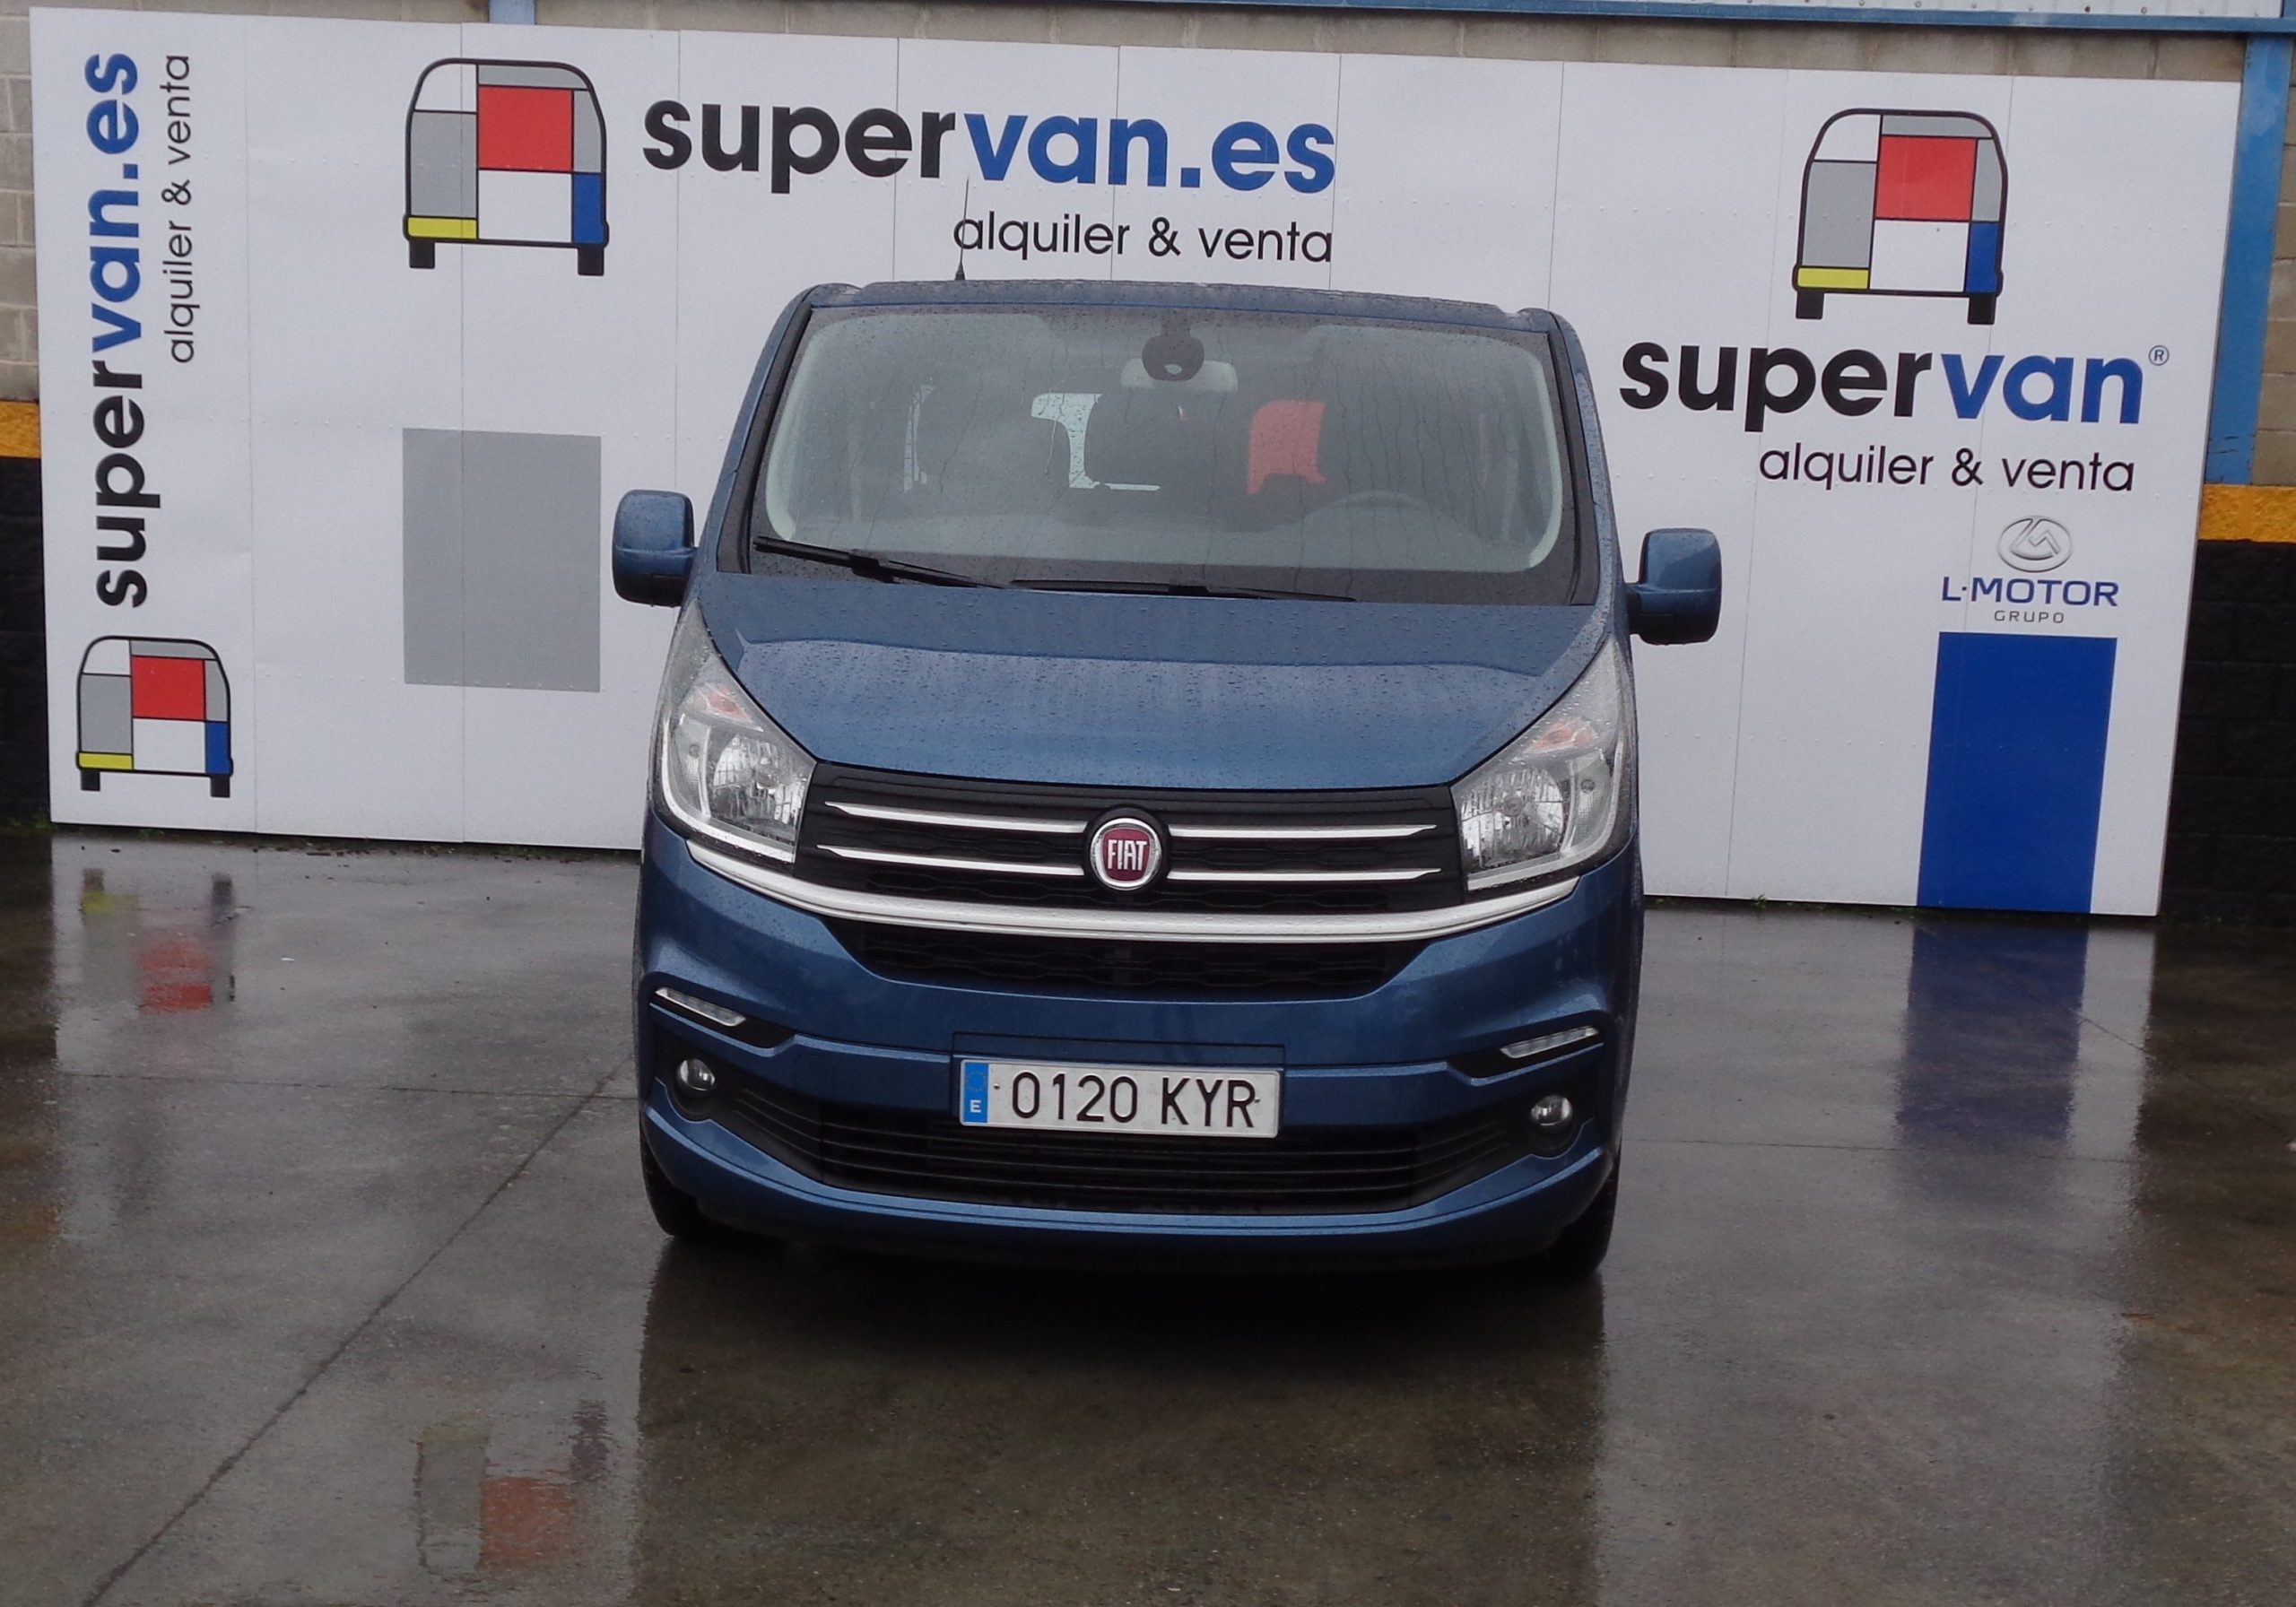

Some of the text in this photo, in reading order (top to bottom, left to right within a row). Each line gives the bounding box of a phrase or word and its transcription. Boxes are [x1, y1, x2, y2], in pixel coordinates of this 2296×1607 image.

[642, 100, 1335, 194] supervan.es
[159, 54, 200, 363] alquiler & venta
[953, 211, 1333, 263] alquiler & venta
[84, 52, 161, 608] supervan.es
[1619, 342, 2144, 432] supervan
[1759, 442, 2135, 491] alquiler & venta
[1994, 610, 2065, 624] GRUPO
[1107, 838, 1148, 872] FIAT
[970, 1071, 1257, 1128] E 0120 KYR
